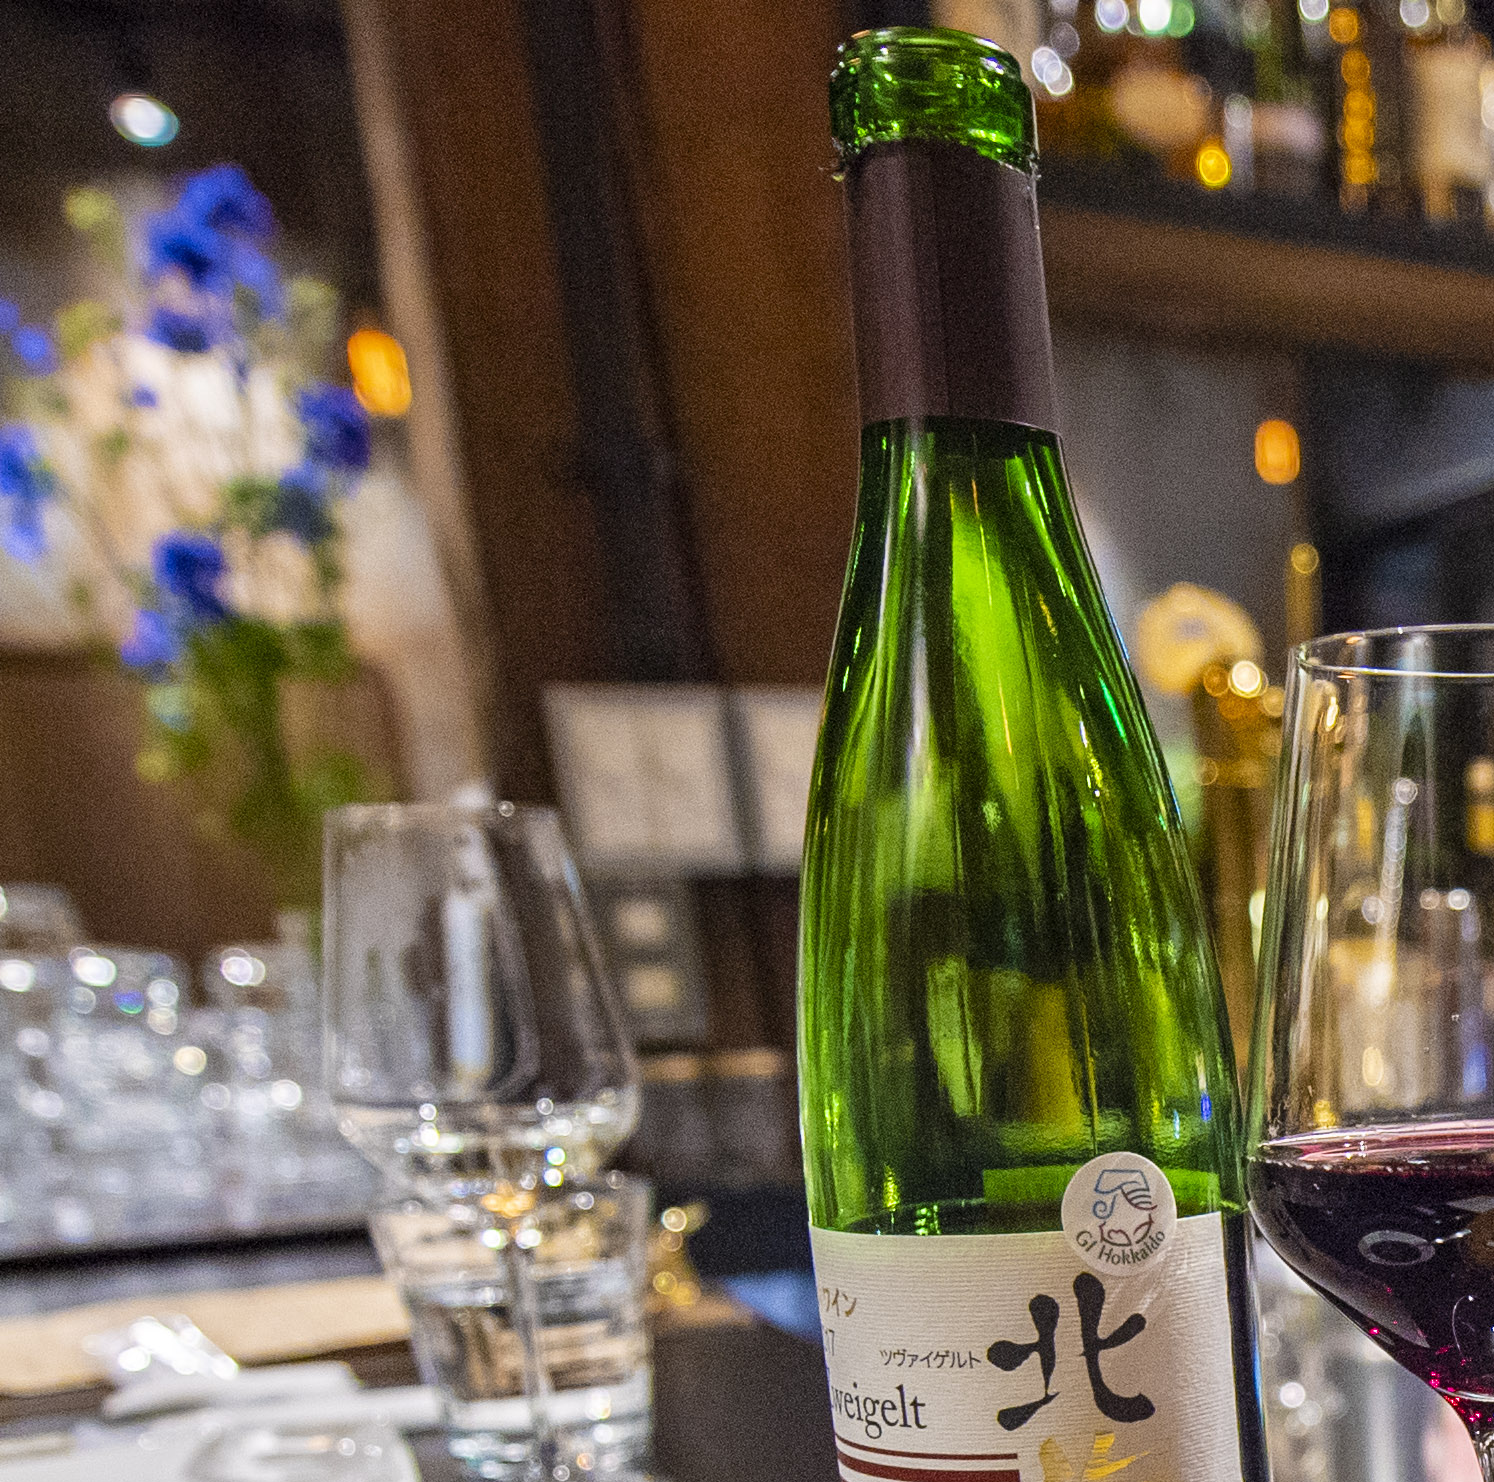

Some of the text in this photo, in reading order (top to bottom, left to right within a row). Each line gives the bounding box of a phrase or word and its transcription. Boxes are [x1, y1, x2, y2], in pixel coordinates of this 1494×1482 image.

[1076, 1230, 1166, 1265] GI Hokkaido
[879, 1348, 982, 1370] ツヴァイゲルト
[830, 1382, 928, 1440] weigelt
